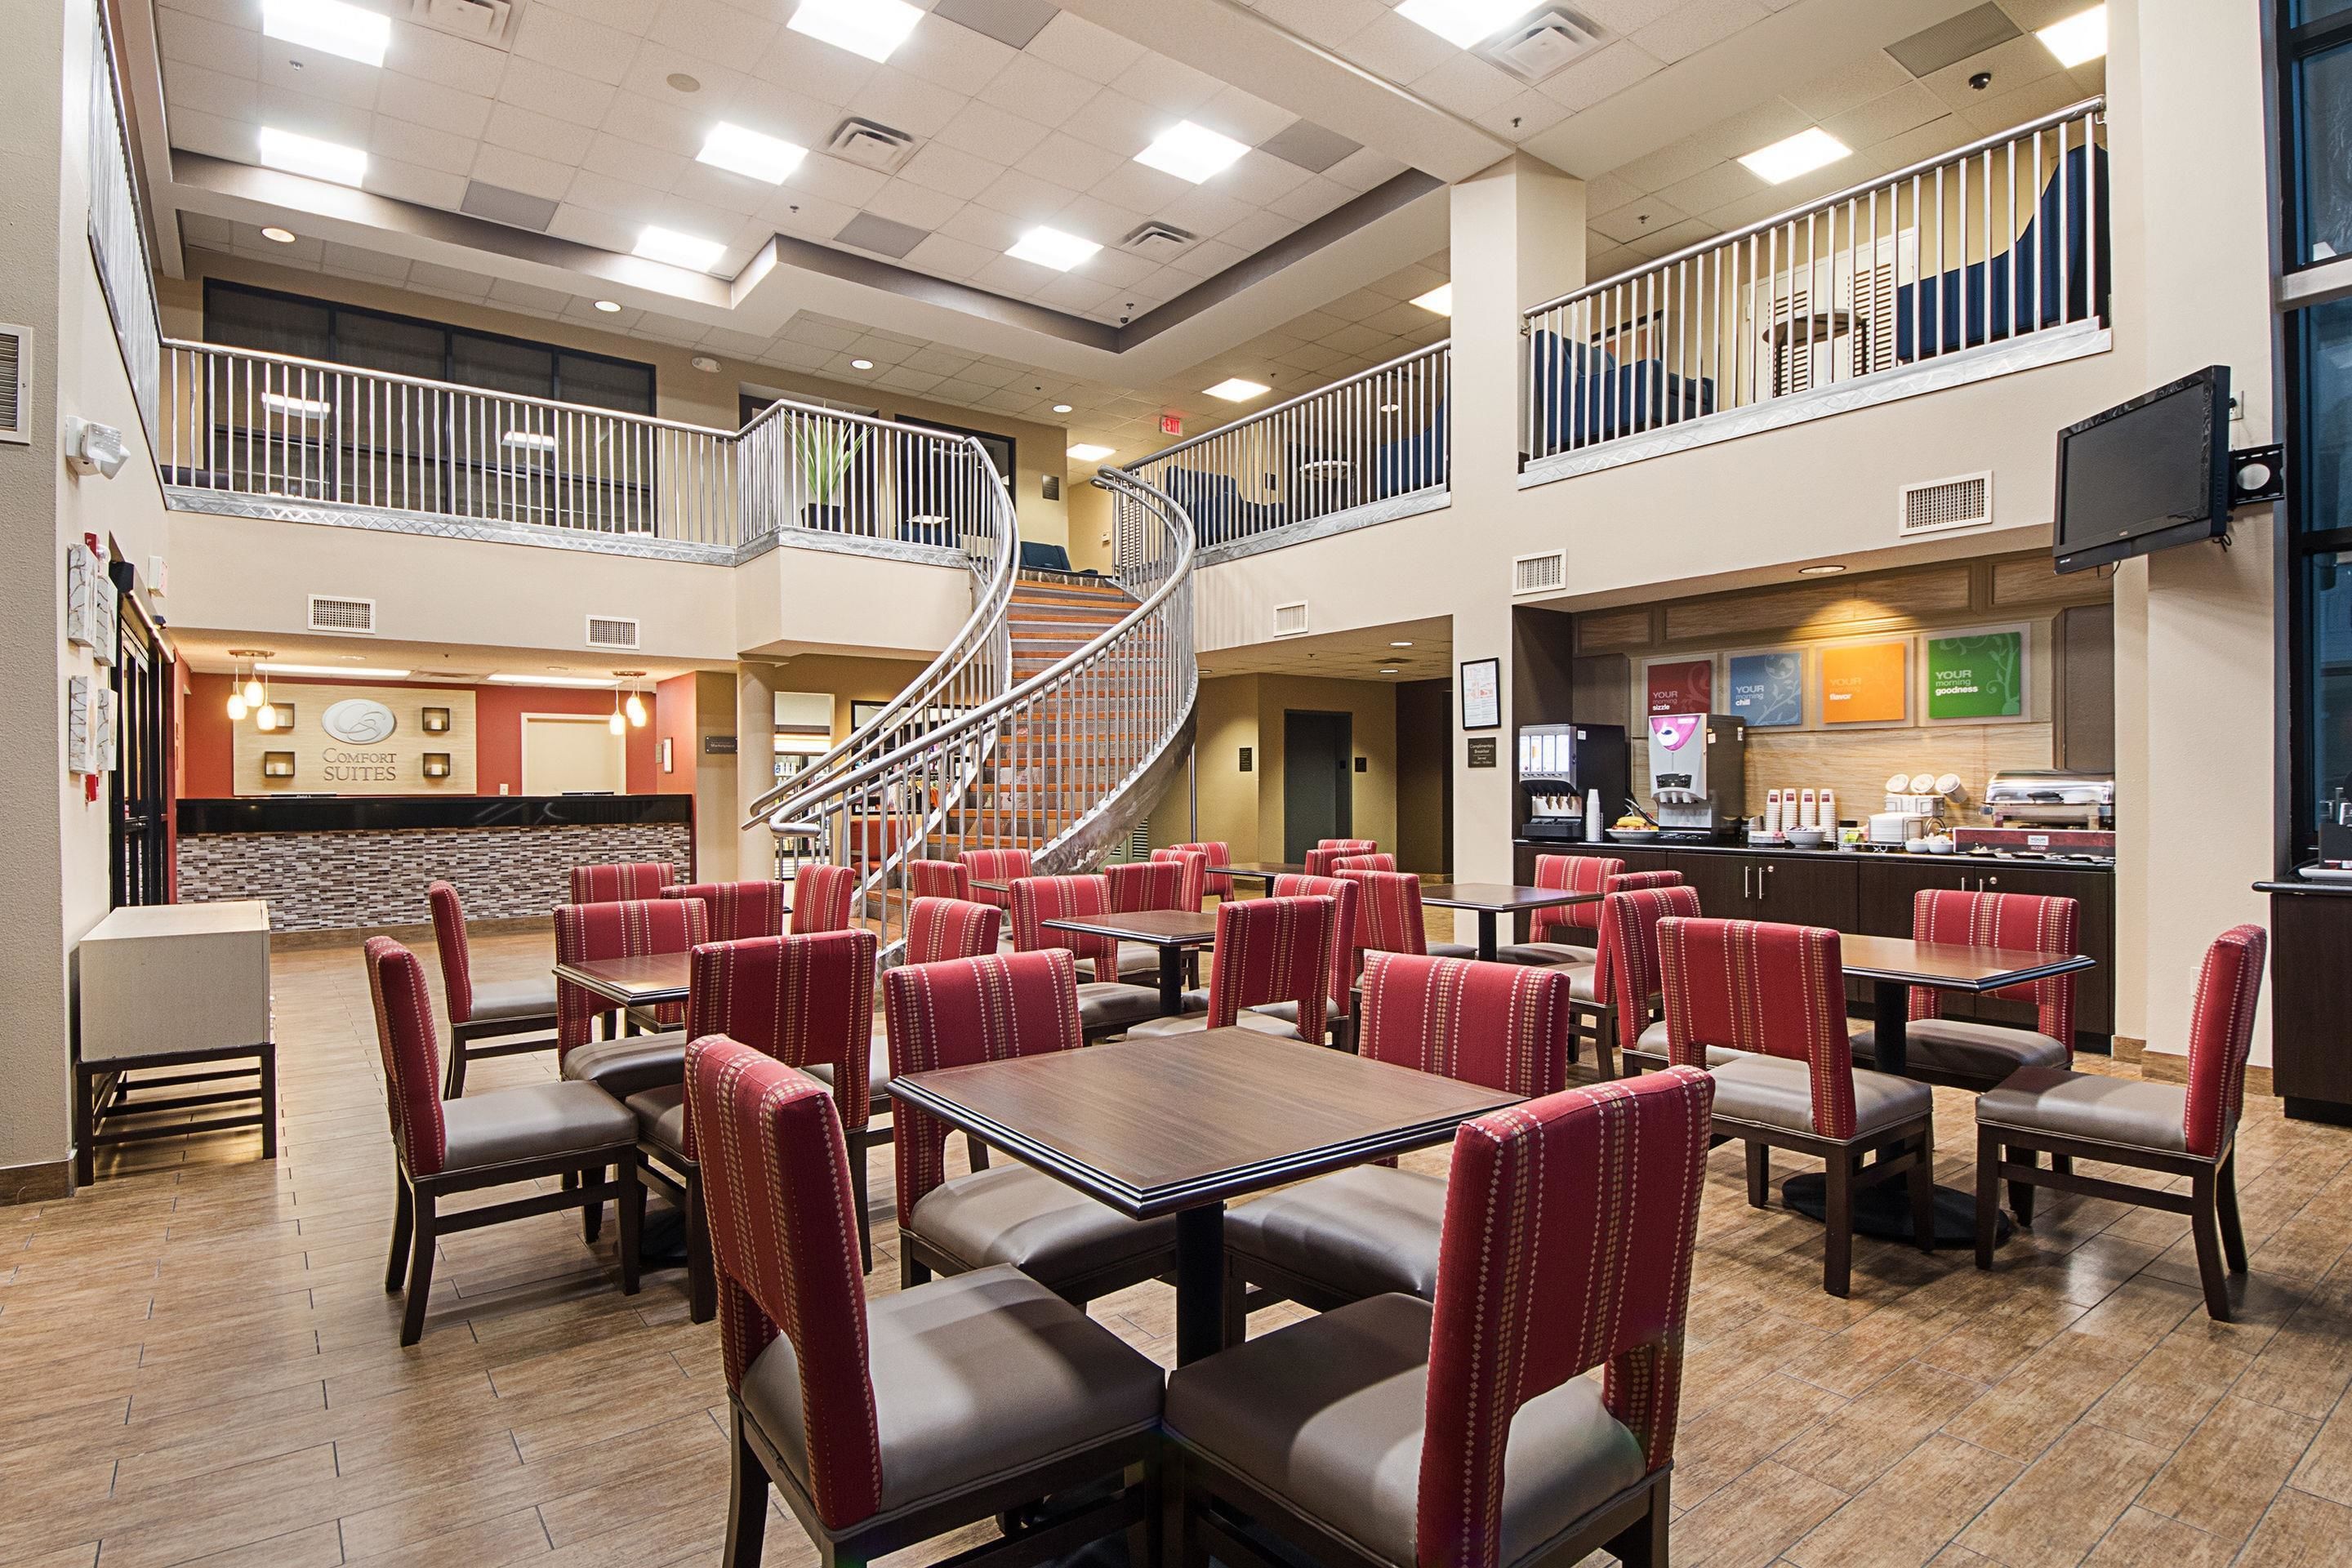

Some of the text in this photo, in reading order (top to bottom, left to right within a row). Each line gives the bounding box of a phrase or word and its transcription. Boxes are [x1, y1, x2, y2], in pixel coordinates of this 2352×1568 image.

[1165, 417, 1179, 434] EXIT
[1936, 670, 1972, 679] YOUR
[1829, 678, 1862, 687] YOUR
[1735, 684, 1764, 694] YOUR
[1935, 686, 1979, 697] goodness
[1652, 690, 1678, 699] YOUR
[323, 766, 396, 781] SUITES
